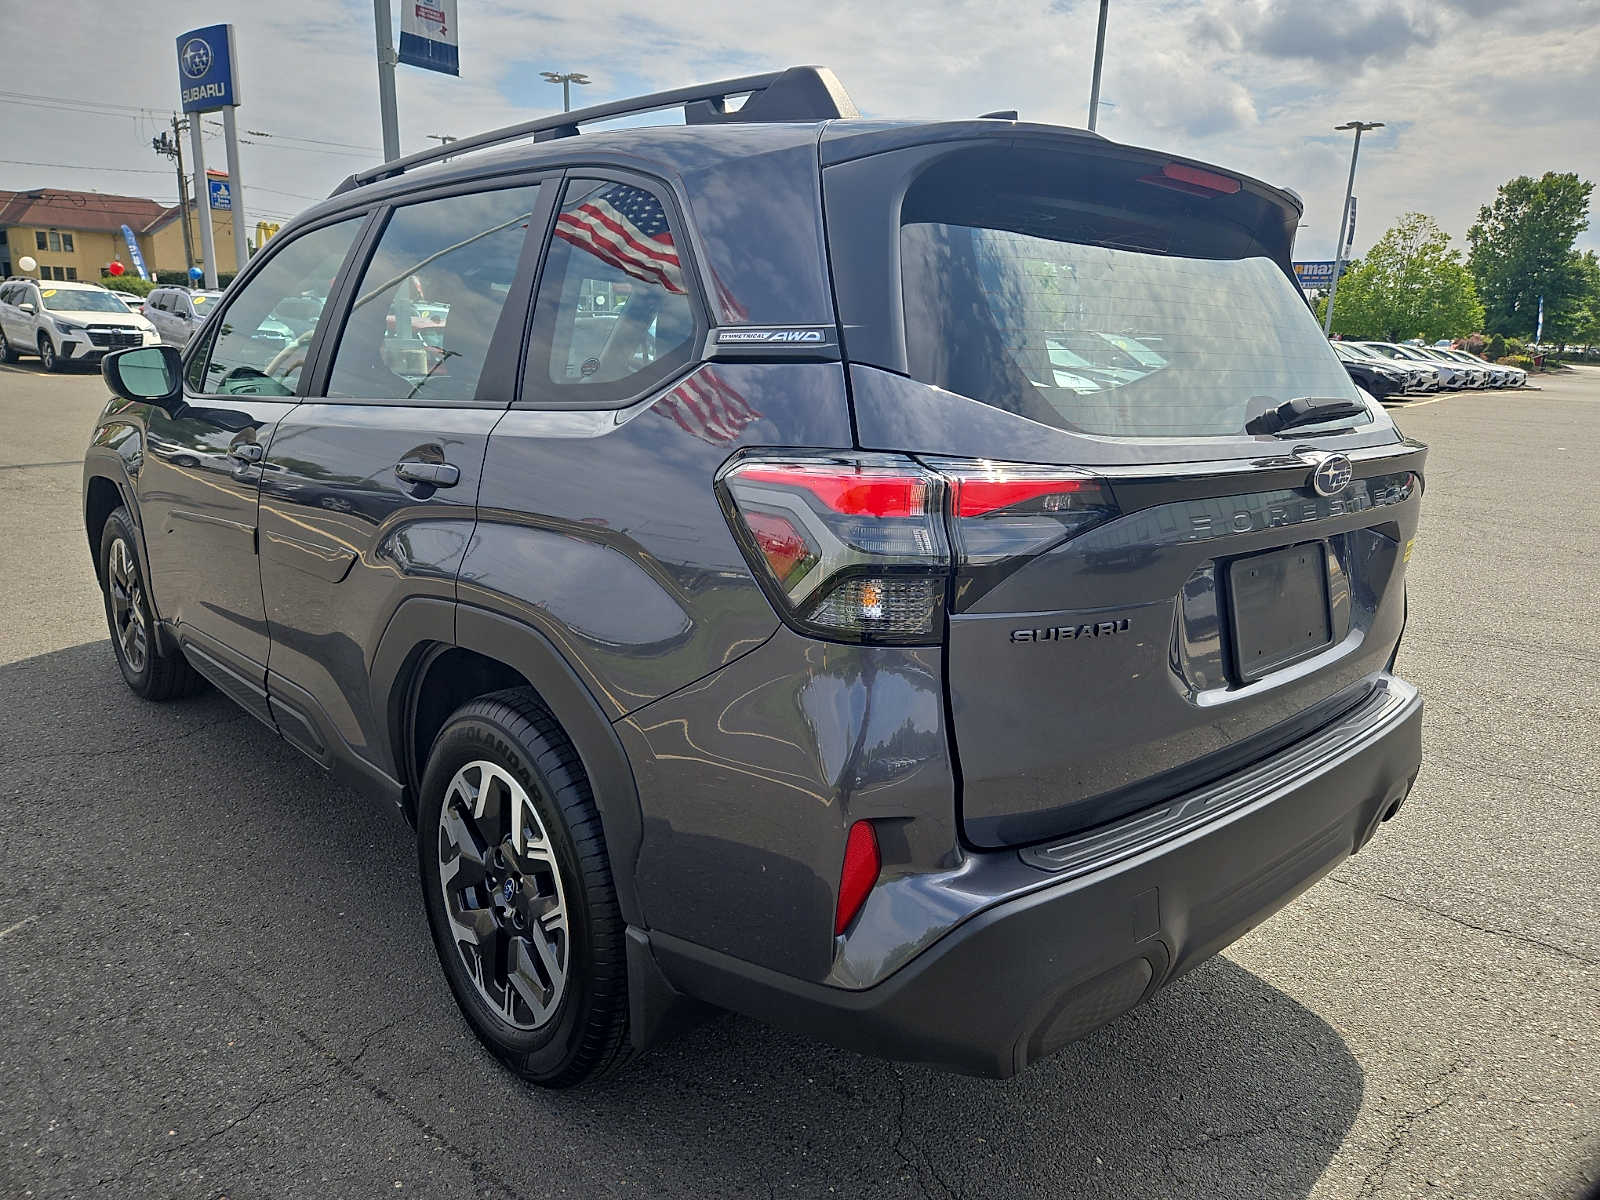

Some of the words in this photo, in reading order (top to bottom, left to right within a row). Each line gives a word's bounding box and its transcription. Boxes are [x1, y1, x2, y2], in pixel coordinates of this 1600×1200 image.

[182, 82, 225, 104] SUBARU
[767, 331, 821, 341] AWD
[1010, 619, 1132, 643] SUBARU
[449, 727, 544, 802] OLANDAR
